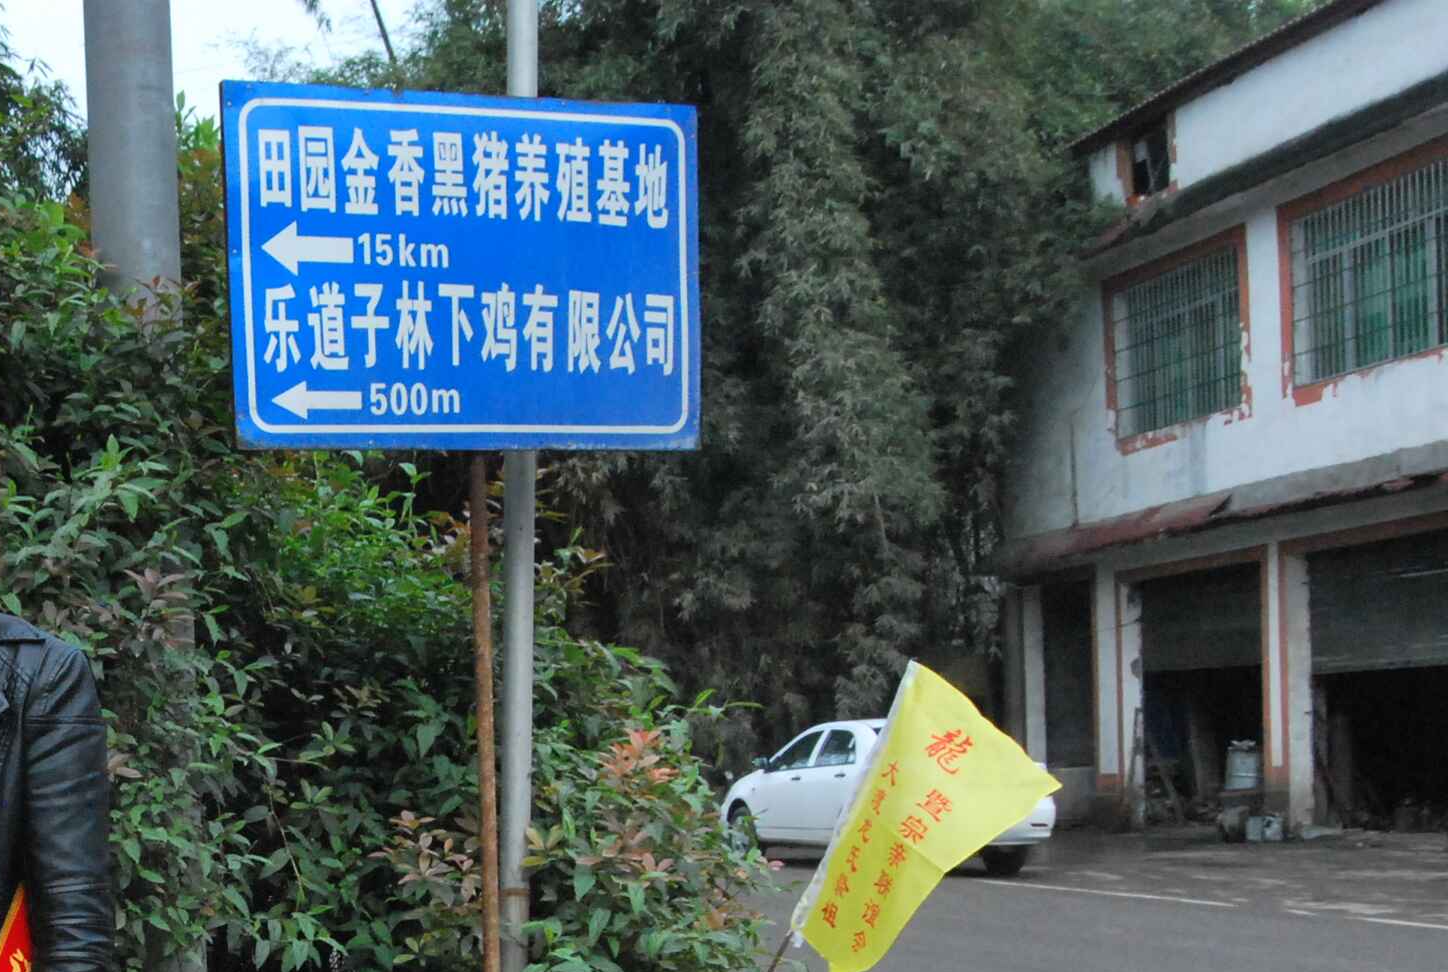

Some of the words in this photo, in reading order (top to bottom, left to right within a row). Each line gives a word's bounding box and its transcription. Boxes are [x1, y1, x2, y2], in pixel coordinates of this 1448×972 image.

[258, 126, 668, 229] 田园金香黑猪养殖基地
[357, 232, 450, 269] 15km
[263, 280, 675, 375] 乐道子林下鸡有限公司
[370, 383, 460, 416] 500m
